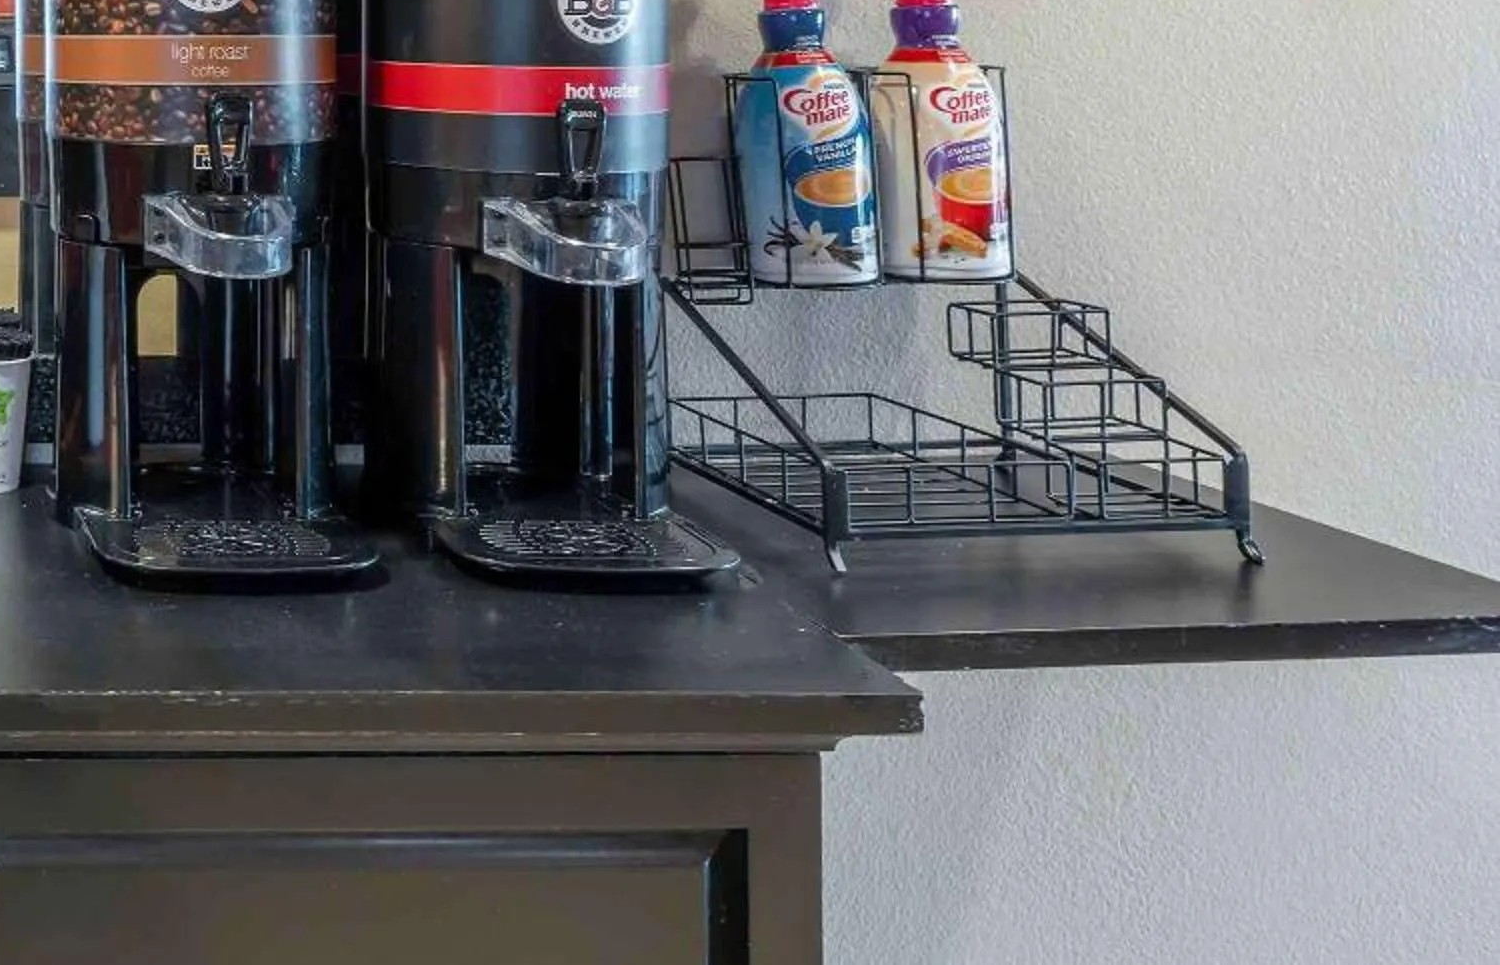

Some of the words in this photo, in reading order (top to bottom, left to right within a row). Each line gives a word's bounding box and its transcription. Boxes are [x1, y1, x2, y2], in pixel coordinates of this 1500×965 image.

[171, 42, 205, 64] light
[209, 45, 252, 60] roast
[565, 82, 596, 100] hot
[784, 88, 849, 116] Coffee
